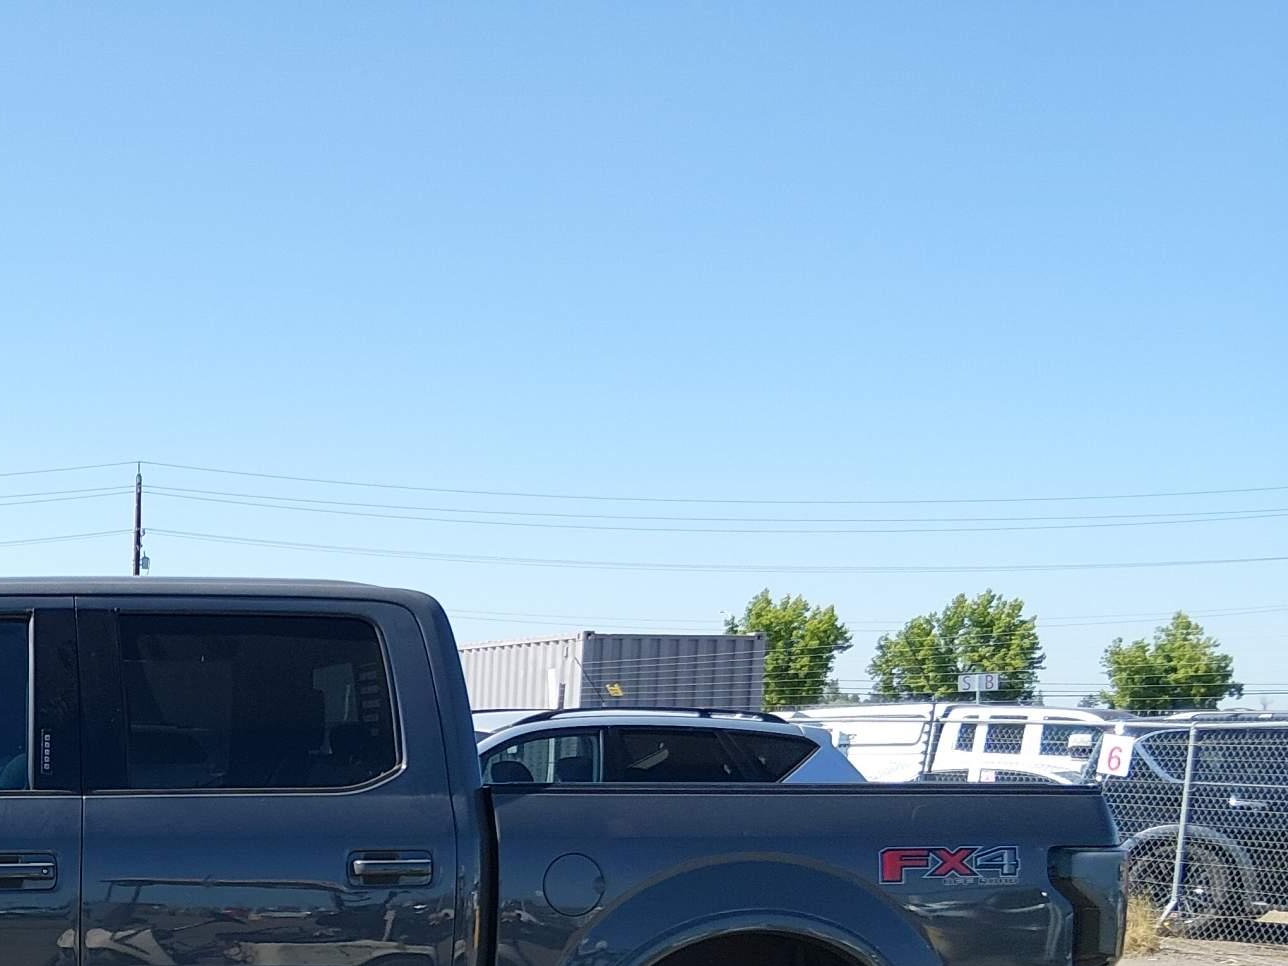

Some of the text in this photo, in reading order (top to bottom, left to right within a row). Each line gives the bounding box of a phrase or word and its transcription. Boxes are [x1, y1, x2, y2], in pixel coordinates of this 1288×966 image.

[962, 675, 971, 691] S
[984, 674, 995, 690] B
[1107, 745, 1123, 771] 6
[878, 845, 1021, 885] FX4
